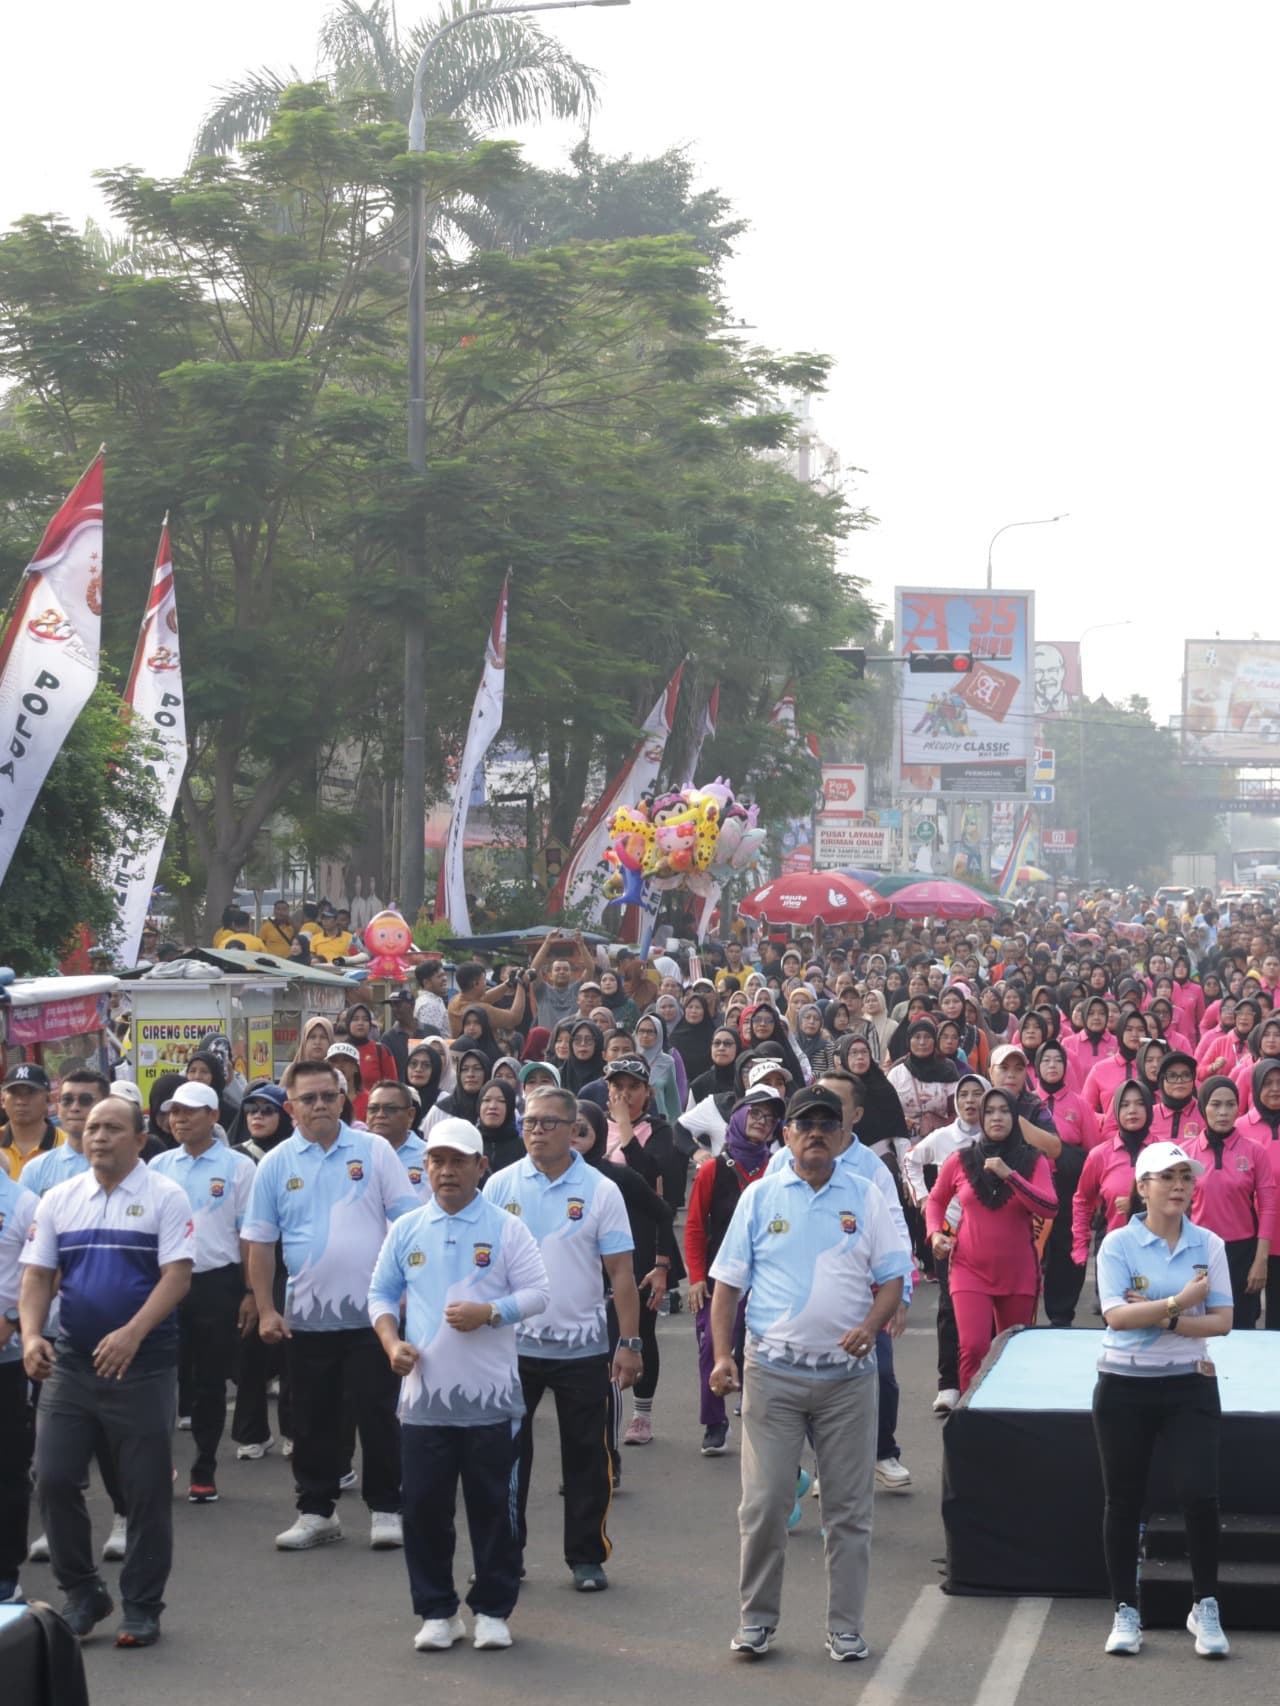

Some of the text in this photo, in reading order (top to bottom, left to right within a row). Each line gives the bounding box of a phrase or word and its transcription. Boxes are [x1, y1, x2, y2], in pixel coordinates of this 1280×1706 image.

[964, 742, 1010, 751] CLASSIC
[849, 831, 885, 839] LAYANAN
[856, 839, 883, 847] ONLINE
[142, 1025, 181, 1040] CIRENG
